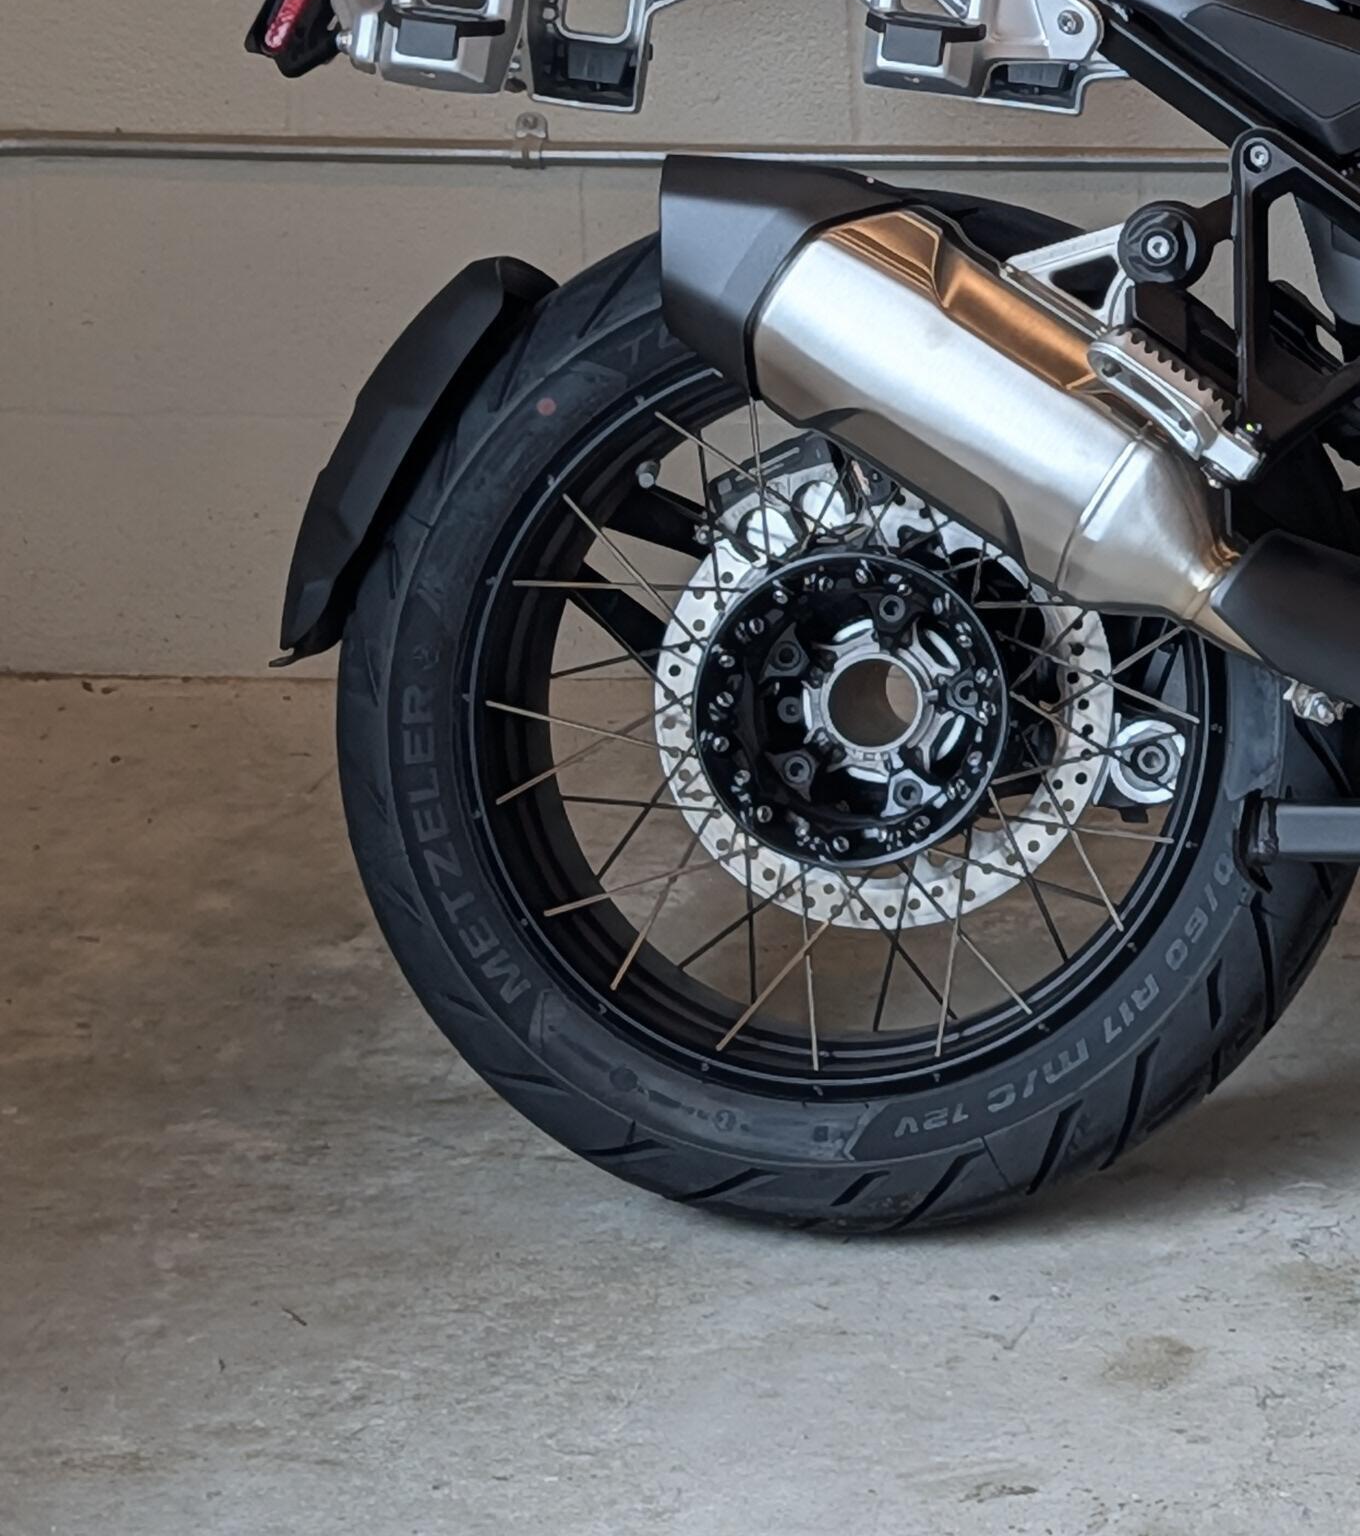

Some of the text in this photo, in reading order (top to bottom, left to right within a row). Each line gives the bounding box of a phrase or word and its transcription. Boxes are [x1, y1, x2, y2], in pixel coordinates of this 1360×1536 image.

[401, 683, 532, 1004] METZELER
[894, 832, 1236, 1137] 0/60 R17 M/C 72V
